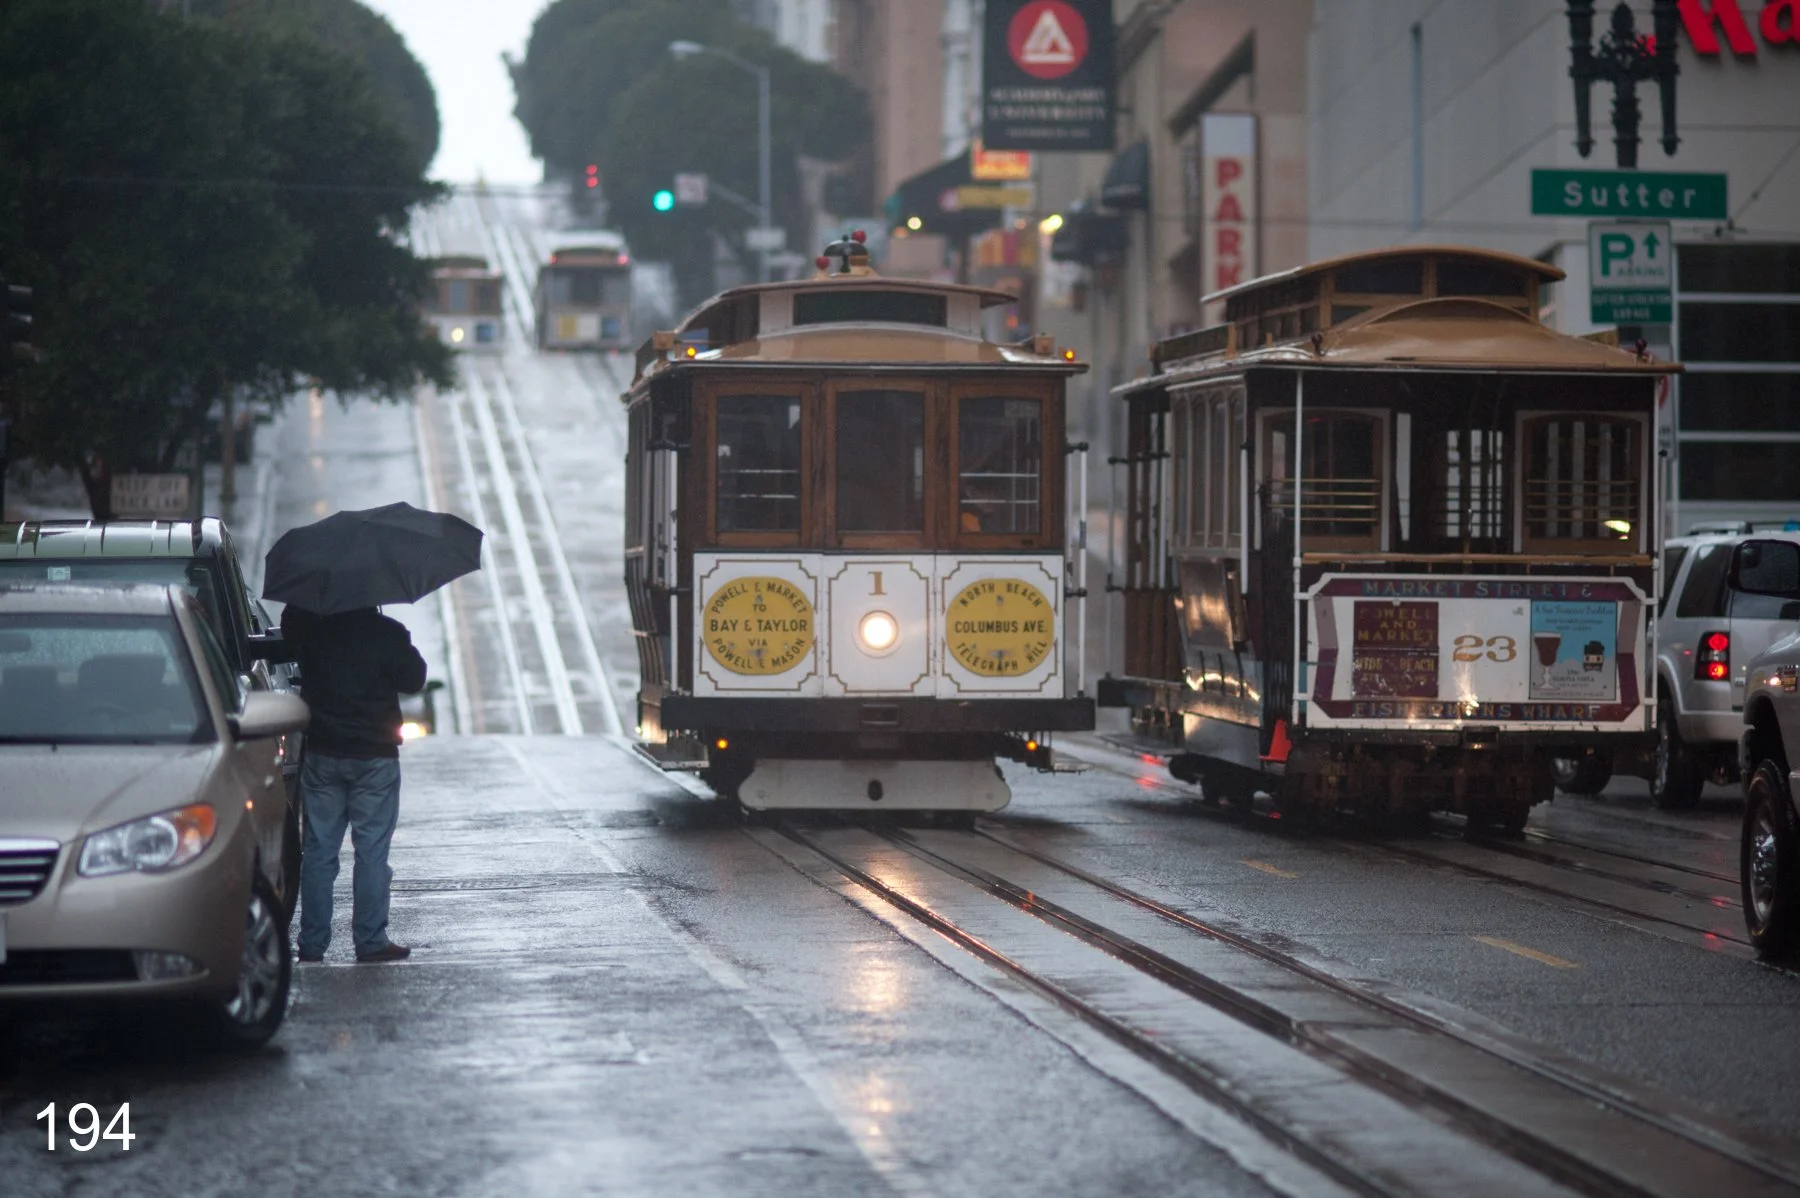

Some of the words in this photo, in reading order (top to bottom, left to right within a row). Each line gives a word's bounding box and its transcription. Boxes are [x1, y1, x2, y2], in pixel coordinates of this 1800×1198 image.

[1564, 181, 1697, 208] Sutter
[867, 571, 887, 596] 1
[1366, 581, 1464, 596] MARKET
[1475, 582, 1567, 597] STREET
[712, 584, 748, 613] POWELL
[767, 583, 807, 613] MARKET
[959, 583, 995, 608] NORTH
[1006, 583, 1043, 607] BEACH
[752, 604, 767, 613] TO
[710, 619, 739, 632] BAY
[757, 619, 808, 632] TAYLOR
[955, 620, 1018, 634] COLUMBUS
[1023, 620, 1047, 634] AVE.
[1380, 620, 1416, 629] AND
[749, 639, 768, 647] VIA
[1358, 630, 1434, 641] MARKET
[713, 638, 753, 669] POWELL
[771, 639, 805, 668] MASON
[956, 642, 1018, 671] TELEGRAPH
[1026, 641, 1047, 664] HILL
[1452, 635, 1517, 663] 23
[1522, 705, 1601, 720] WHARF
